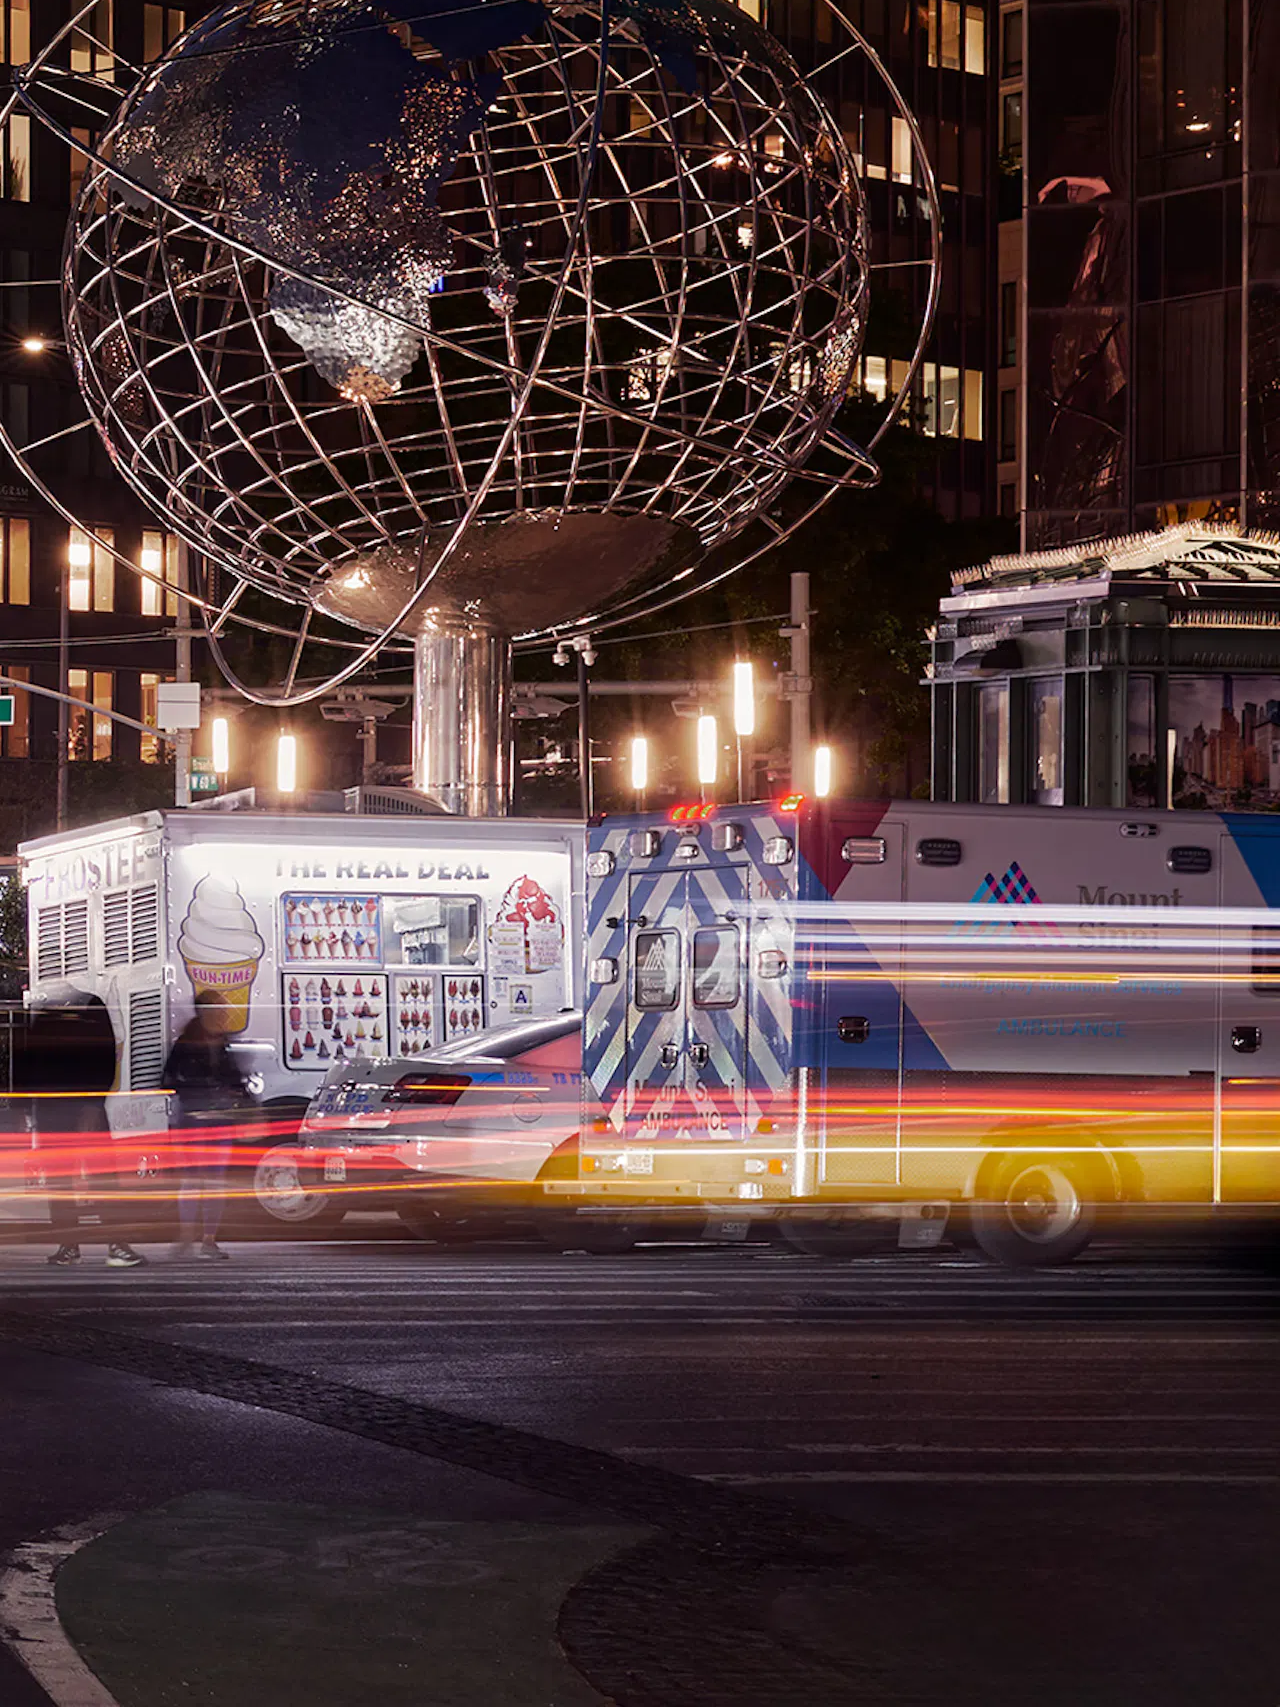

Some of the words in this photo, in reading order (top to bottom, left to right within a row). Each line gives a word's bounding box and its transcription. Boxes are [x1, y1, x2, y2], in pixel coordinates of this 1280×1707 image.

[43, 839, 146, 900] FROSTEE
[276, 858, 327, 879] THE
[336, 858, 410, 880] REAL
[417, 858, 490, 880] DEAL
[192, 966, 253, 985] FUN-TIME
[515, 989, 528, 1004] A
[996, 1019, 1127, 1038] AMBULANCE
